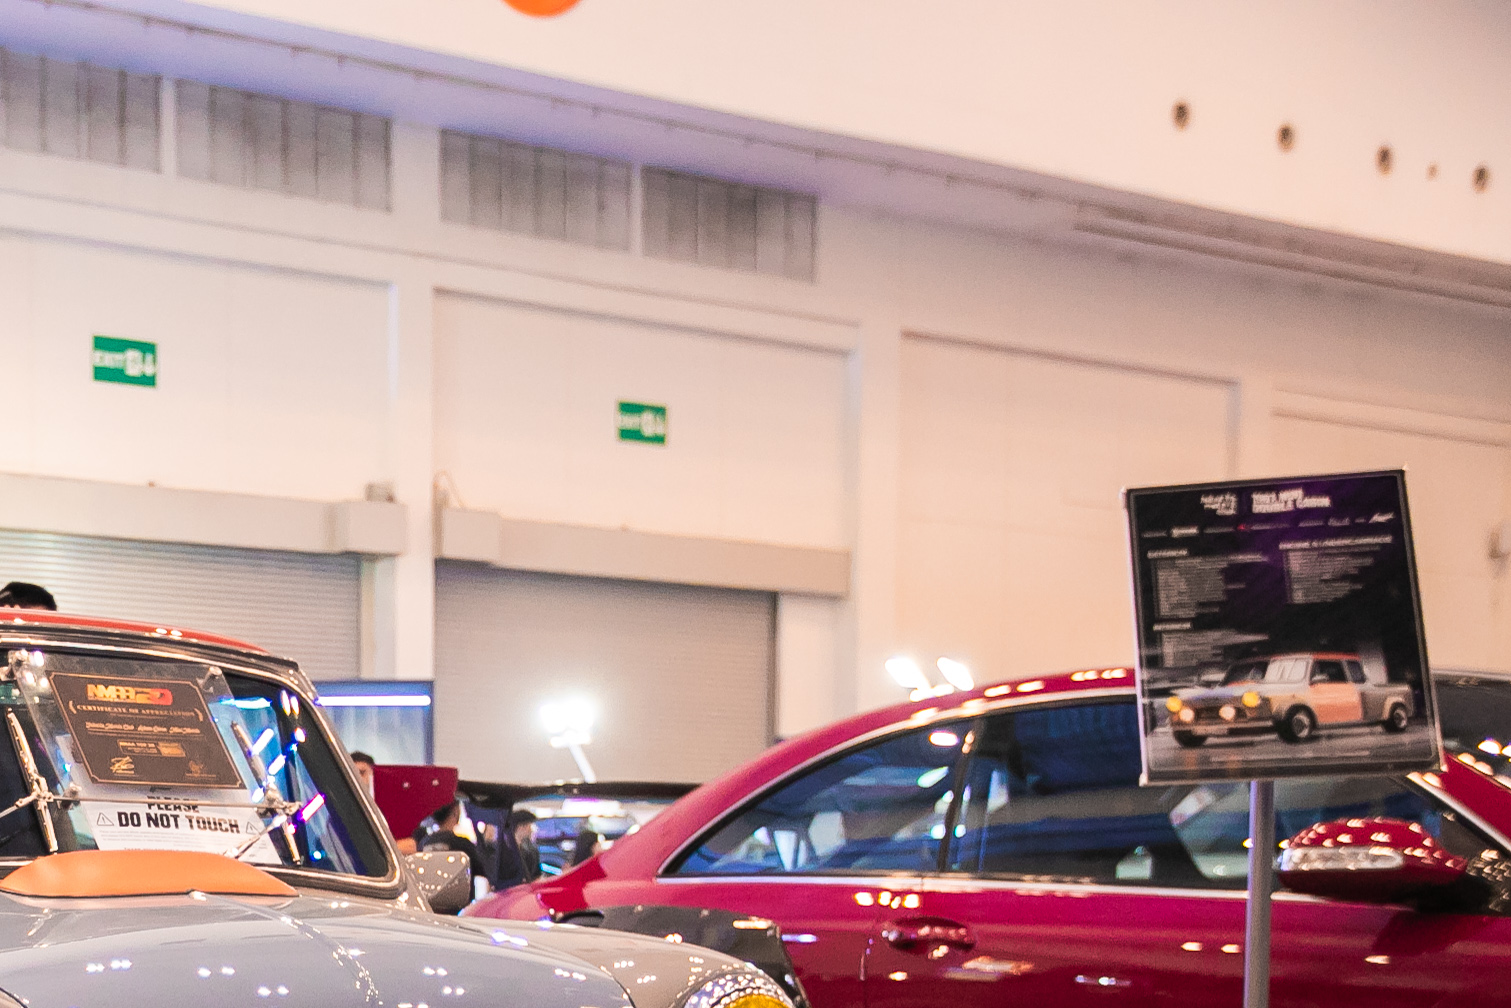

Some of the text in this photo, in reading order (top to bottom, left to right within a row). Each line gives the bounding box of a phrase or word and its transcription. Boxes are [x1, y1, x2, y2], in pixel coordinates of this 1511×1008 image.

[76, 704, 128, 713] CERTIFICATE
[147, 795, 200, 813] PLEASE
[117, 811, 241, 834] DO NOT TOUCH
